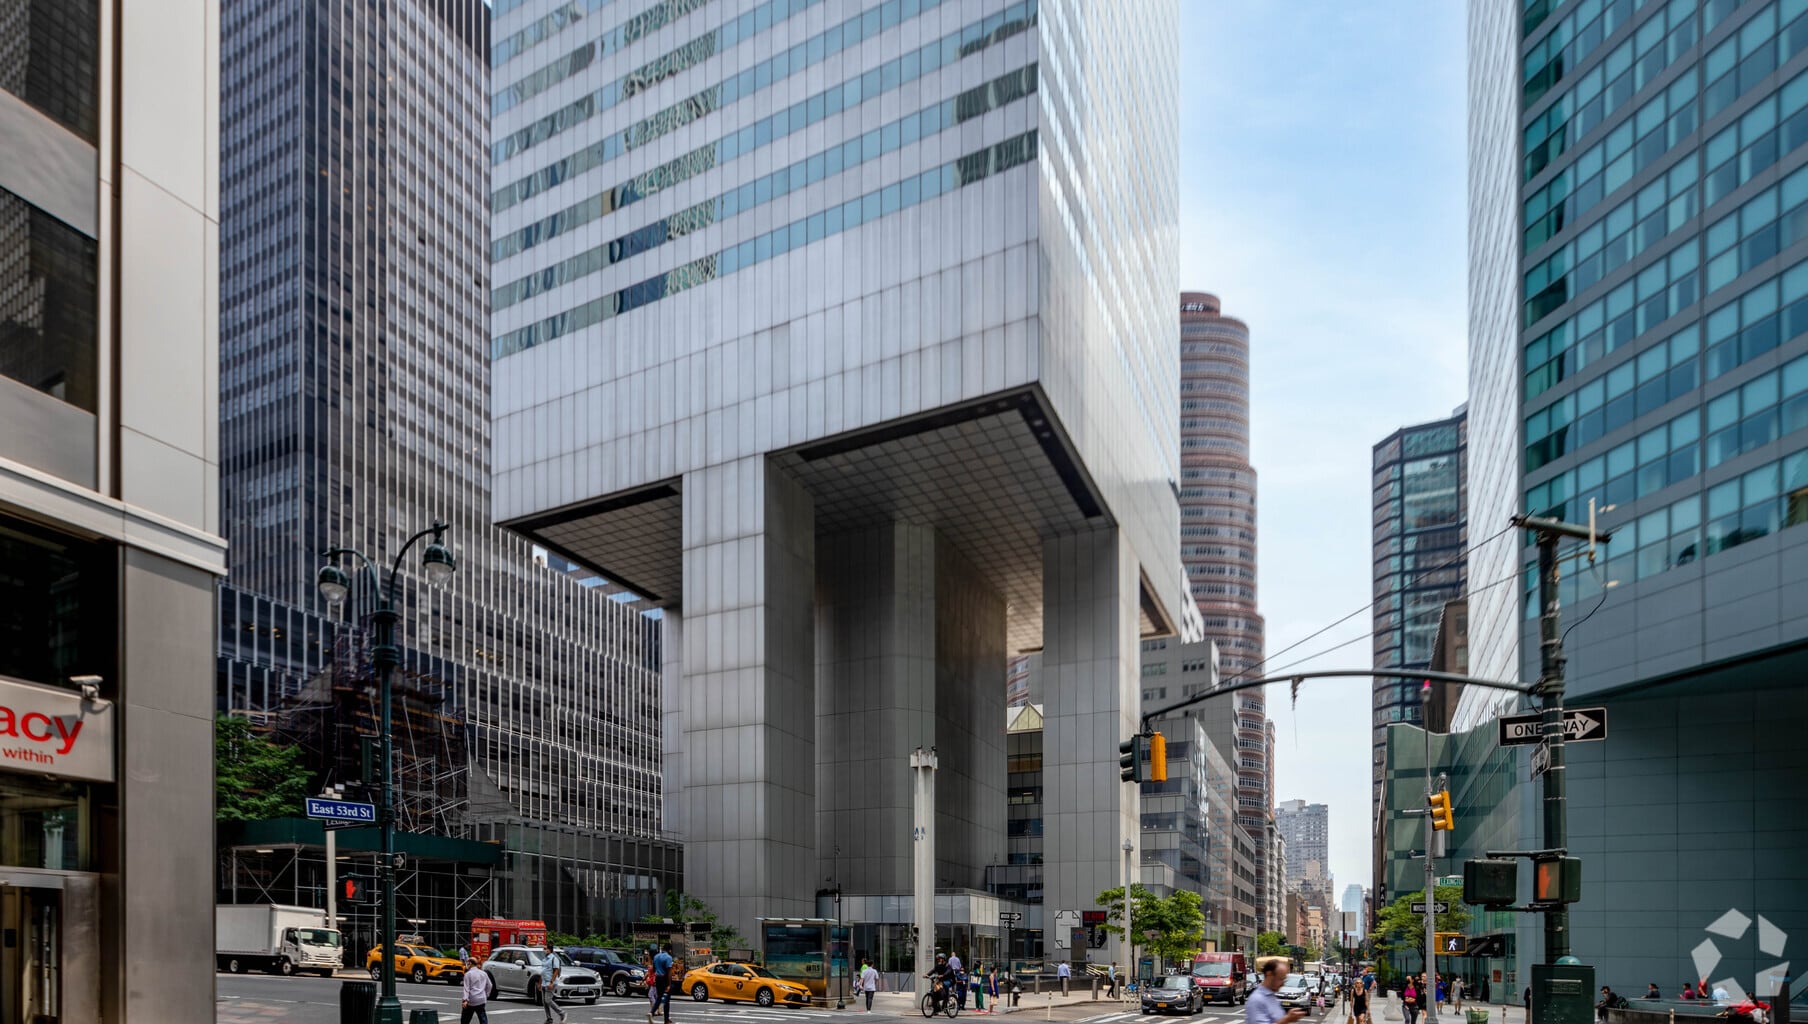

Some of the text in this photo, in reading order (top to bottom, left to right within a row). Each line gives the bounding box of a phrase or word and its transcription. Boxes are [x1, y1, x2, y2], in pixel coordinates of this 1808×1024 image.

[0, 705, 84, 755] acy
[1514, 724, 1543, 736] ONE
[2, 747, 54, 765] within
[311, 802, 371, 818] East 53rd St
